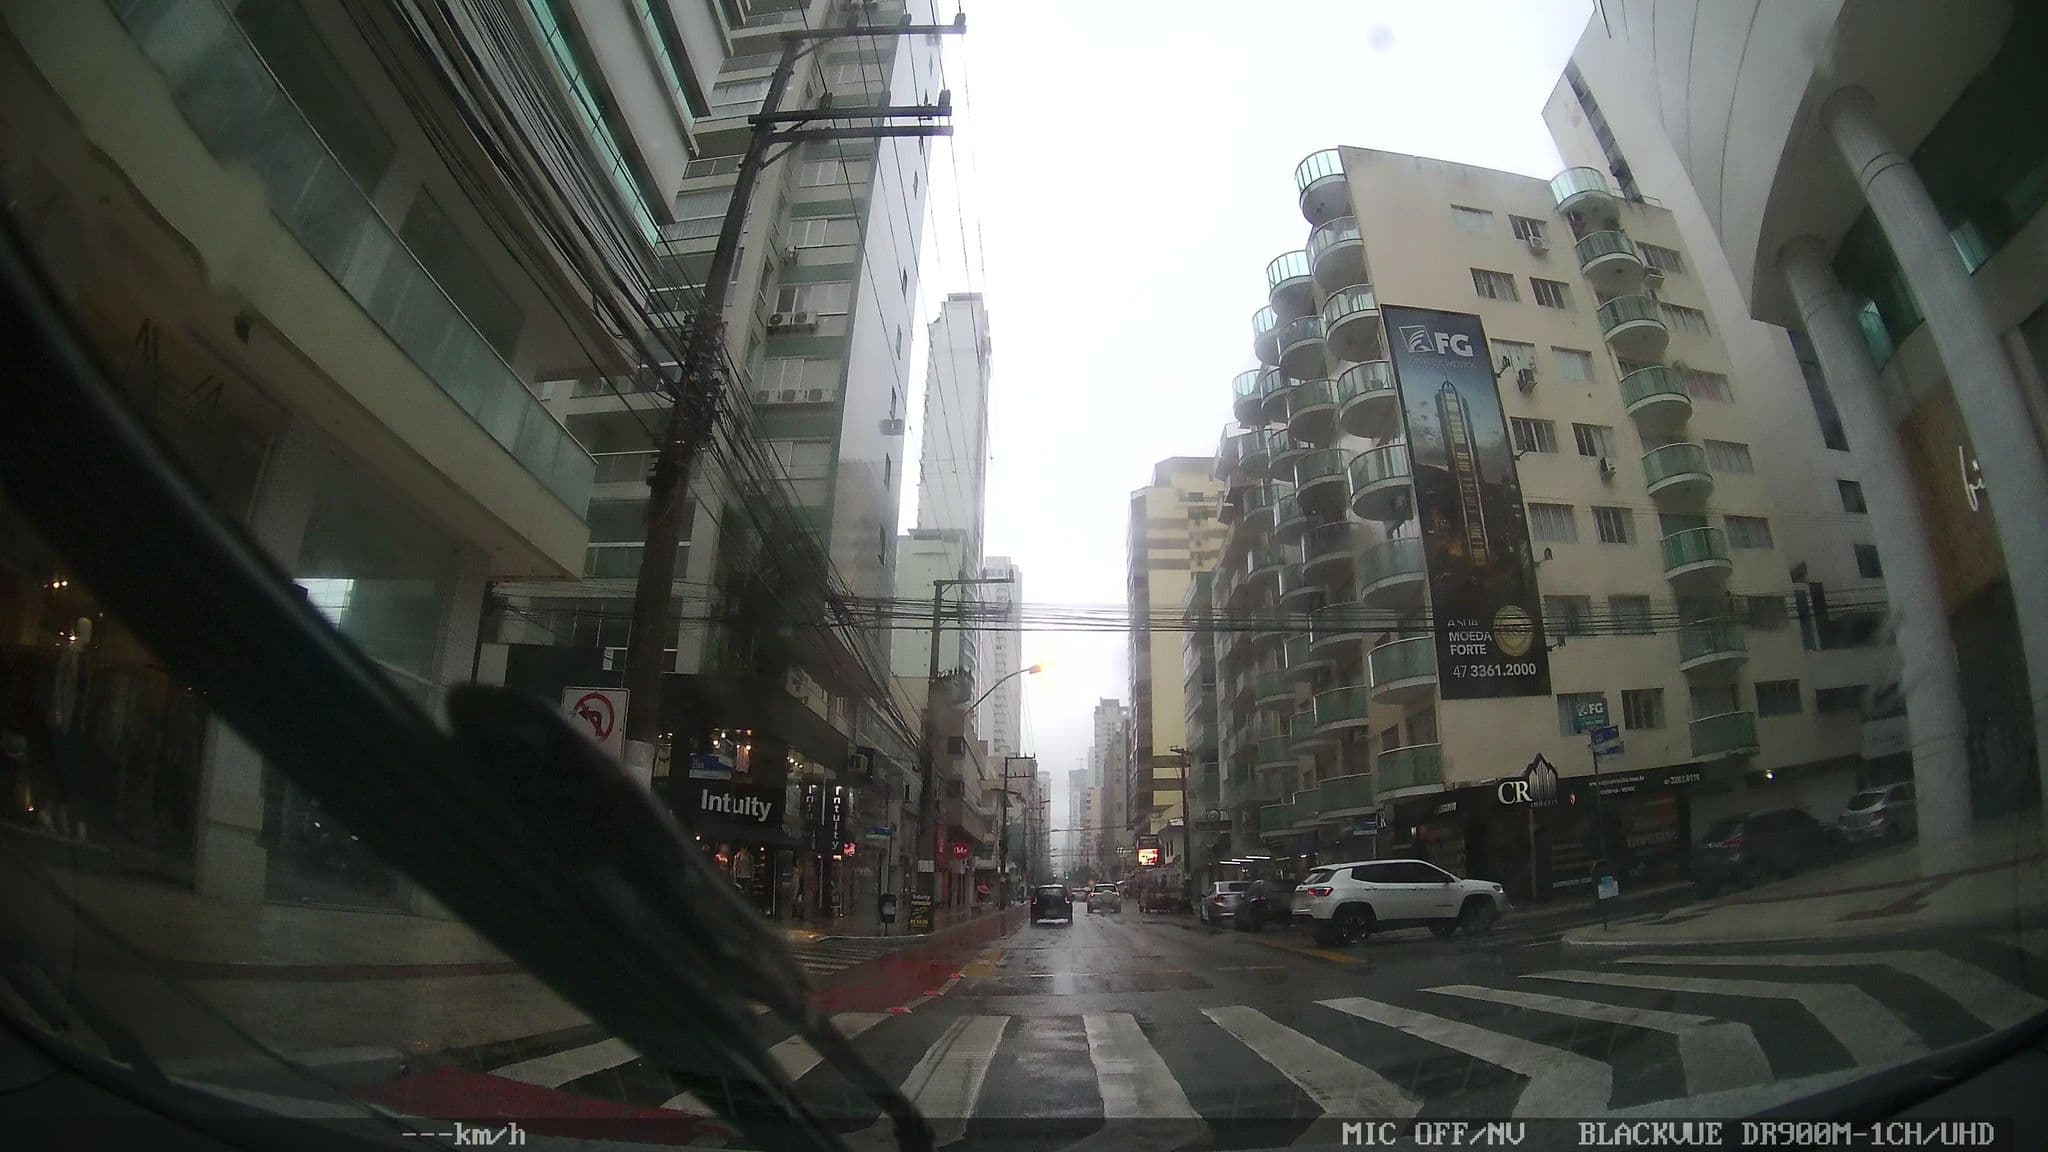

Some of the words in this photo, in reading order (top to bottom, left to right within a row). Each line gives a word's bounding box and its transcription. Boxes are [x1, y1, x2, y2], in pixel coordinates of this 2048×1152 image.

[1434, 332, 1474, 357] FG
[1448, 631, 1493, 642] MOEDA
[1450, 644, 1487, 656] FORTE
[1453, 665, 1468, 678] 47
[1470, 663, 1537, 678] 3361.2000
[1497, 781, 1534, 805] CR
